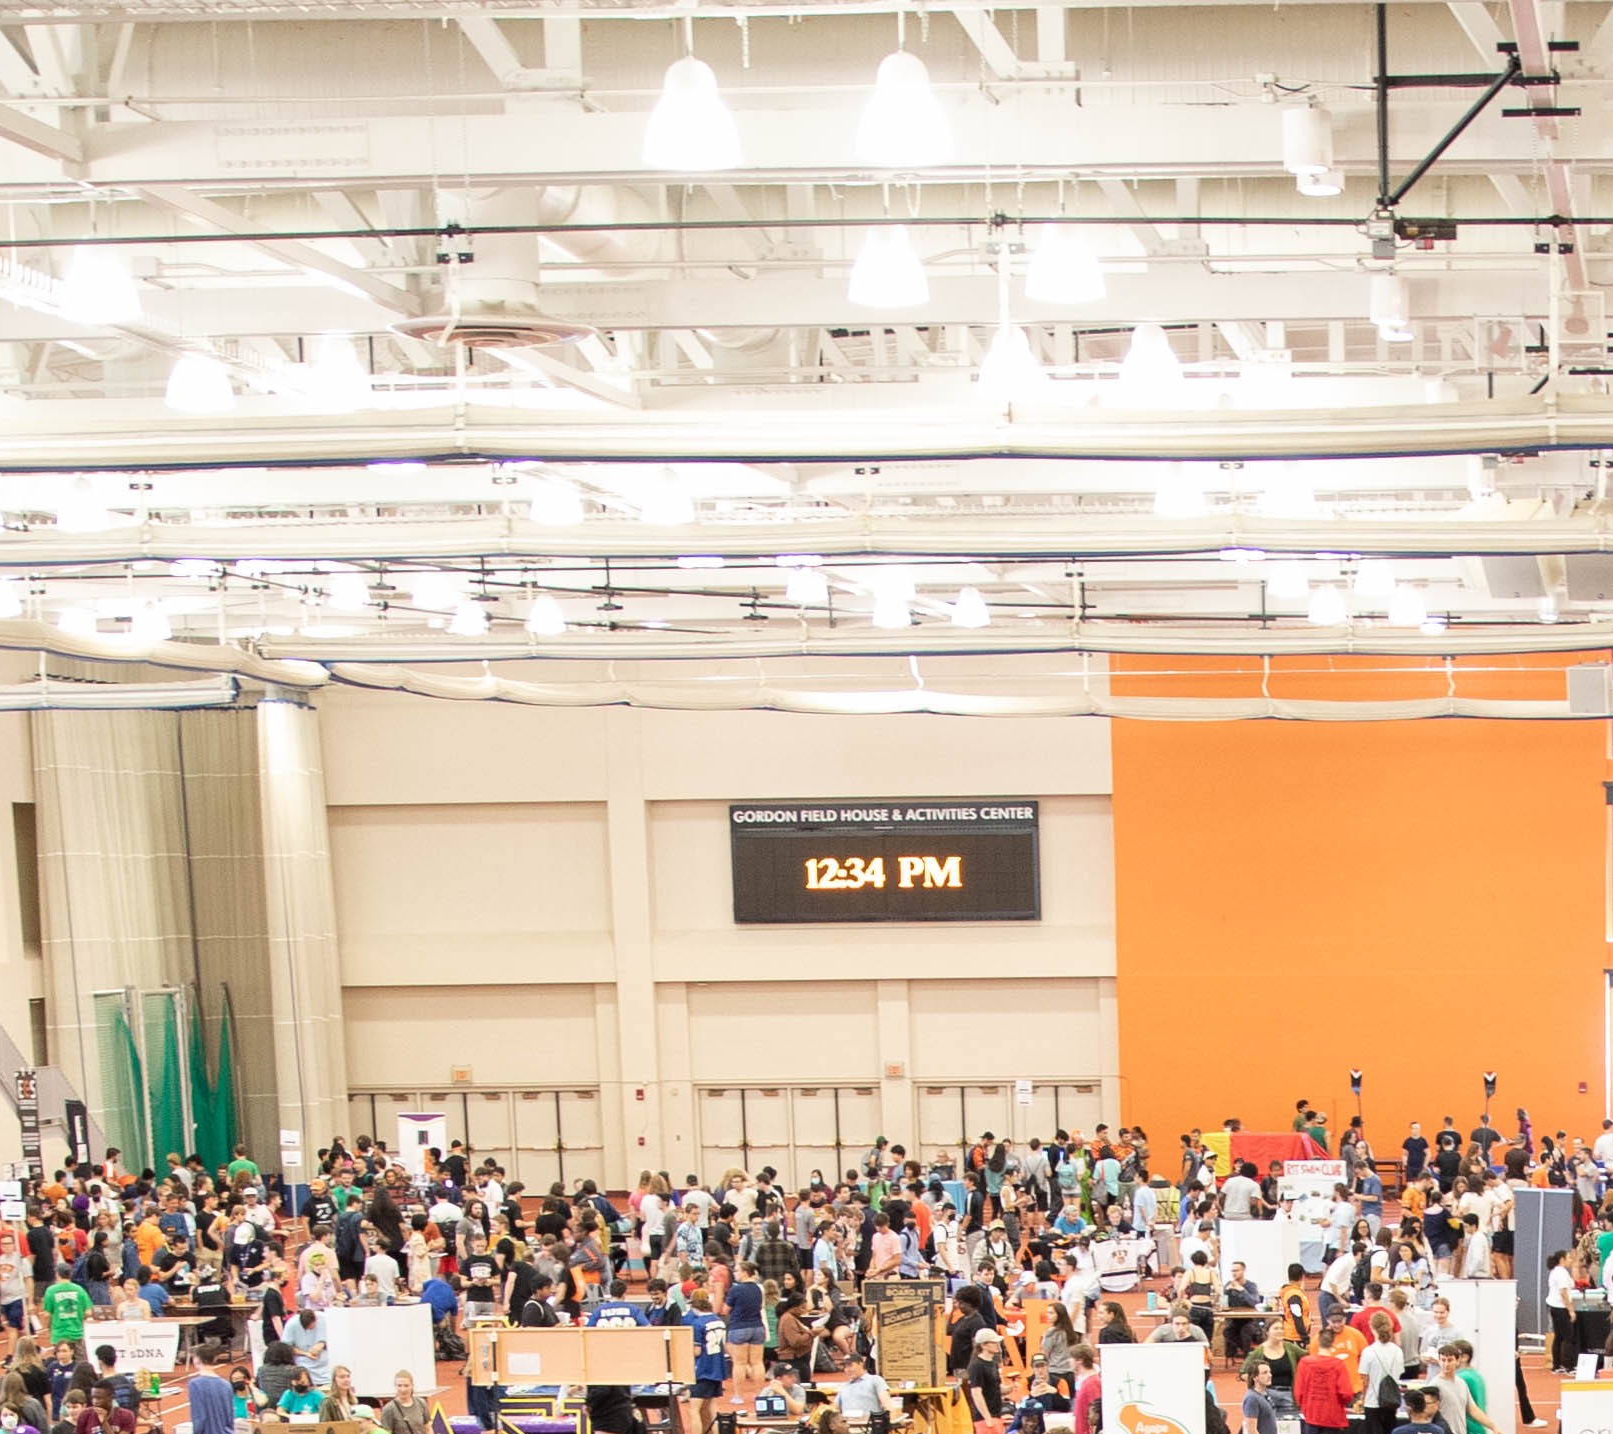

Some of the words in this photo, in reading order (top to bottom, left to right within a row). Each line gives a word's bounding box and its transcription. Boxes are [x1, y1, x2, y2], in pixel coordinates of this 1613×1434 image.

[733, 808, 797, 823] GORDON
[800, 808, 837, 822] FIELD
[839, 807, 888, 821] HOUSE
[891, 807, 904, 820] &
[907, 806, 979, 820] ACTIVITIES
[981, 805, 1035, 819] CENTER
[804, 858, 886, 890] 12:34
[898, 856, 963, 888] PM
